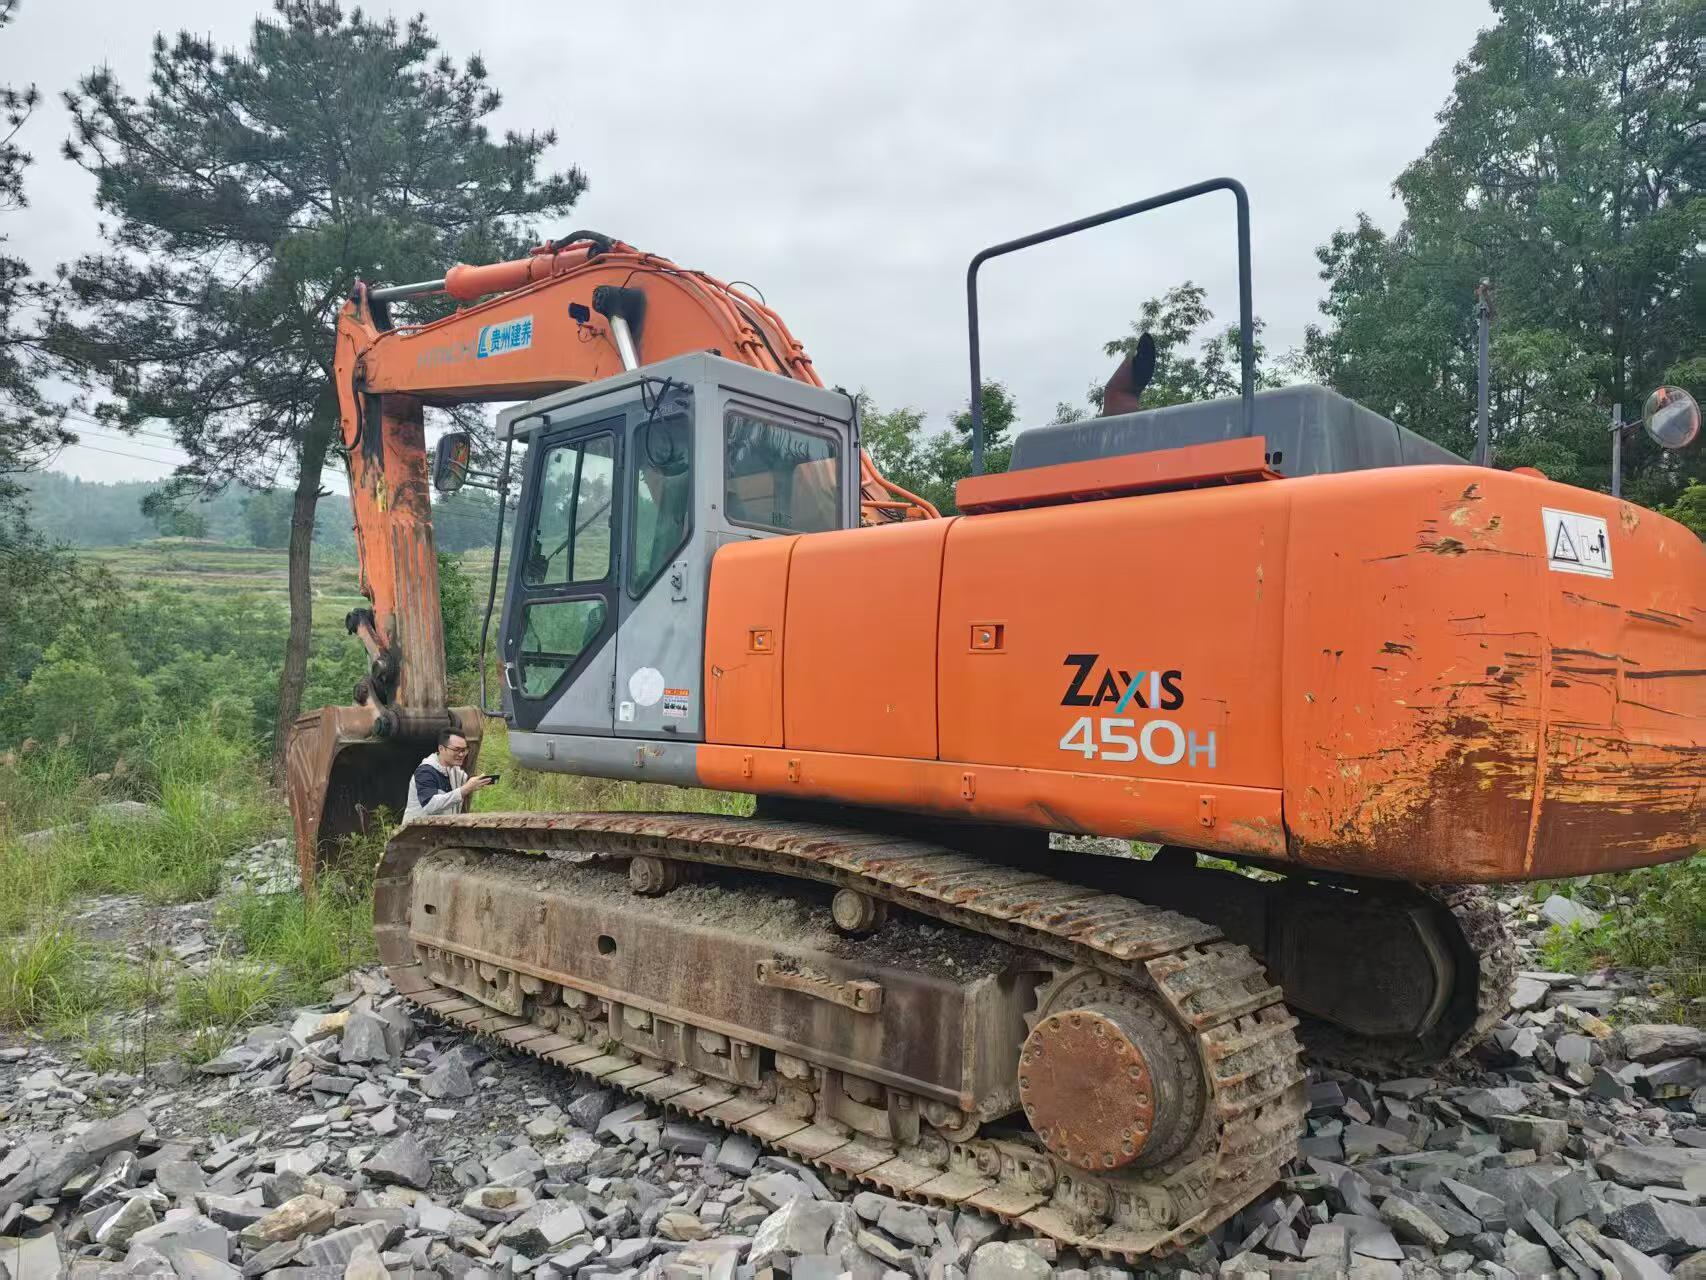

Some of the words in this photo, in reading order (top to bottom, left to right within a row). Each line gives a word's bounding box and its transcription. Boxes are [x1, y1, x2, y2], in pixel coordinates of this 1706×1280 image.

[490, 320, 532, 352] 贵州建养
[1060, 654, 1184, 714] ZAXIS
